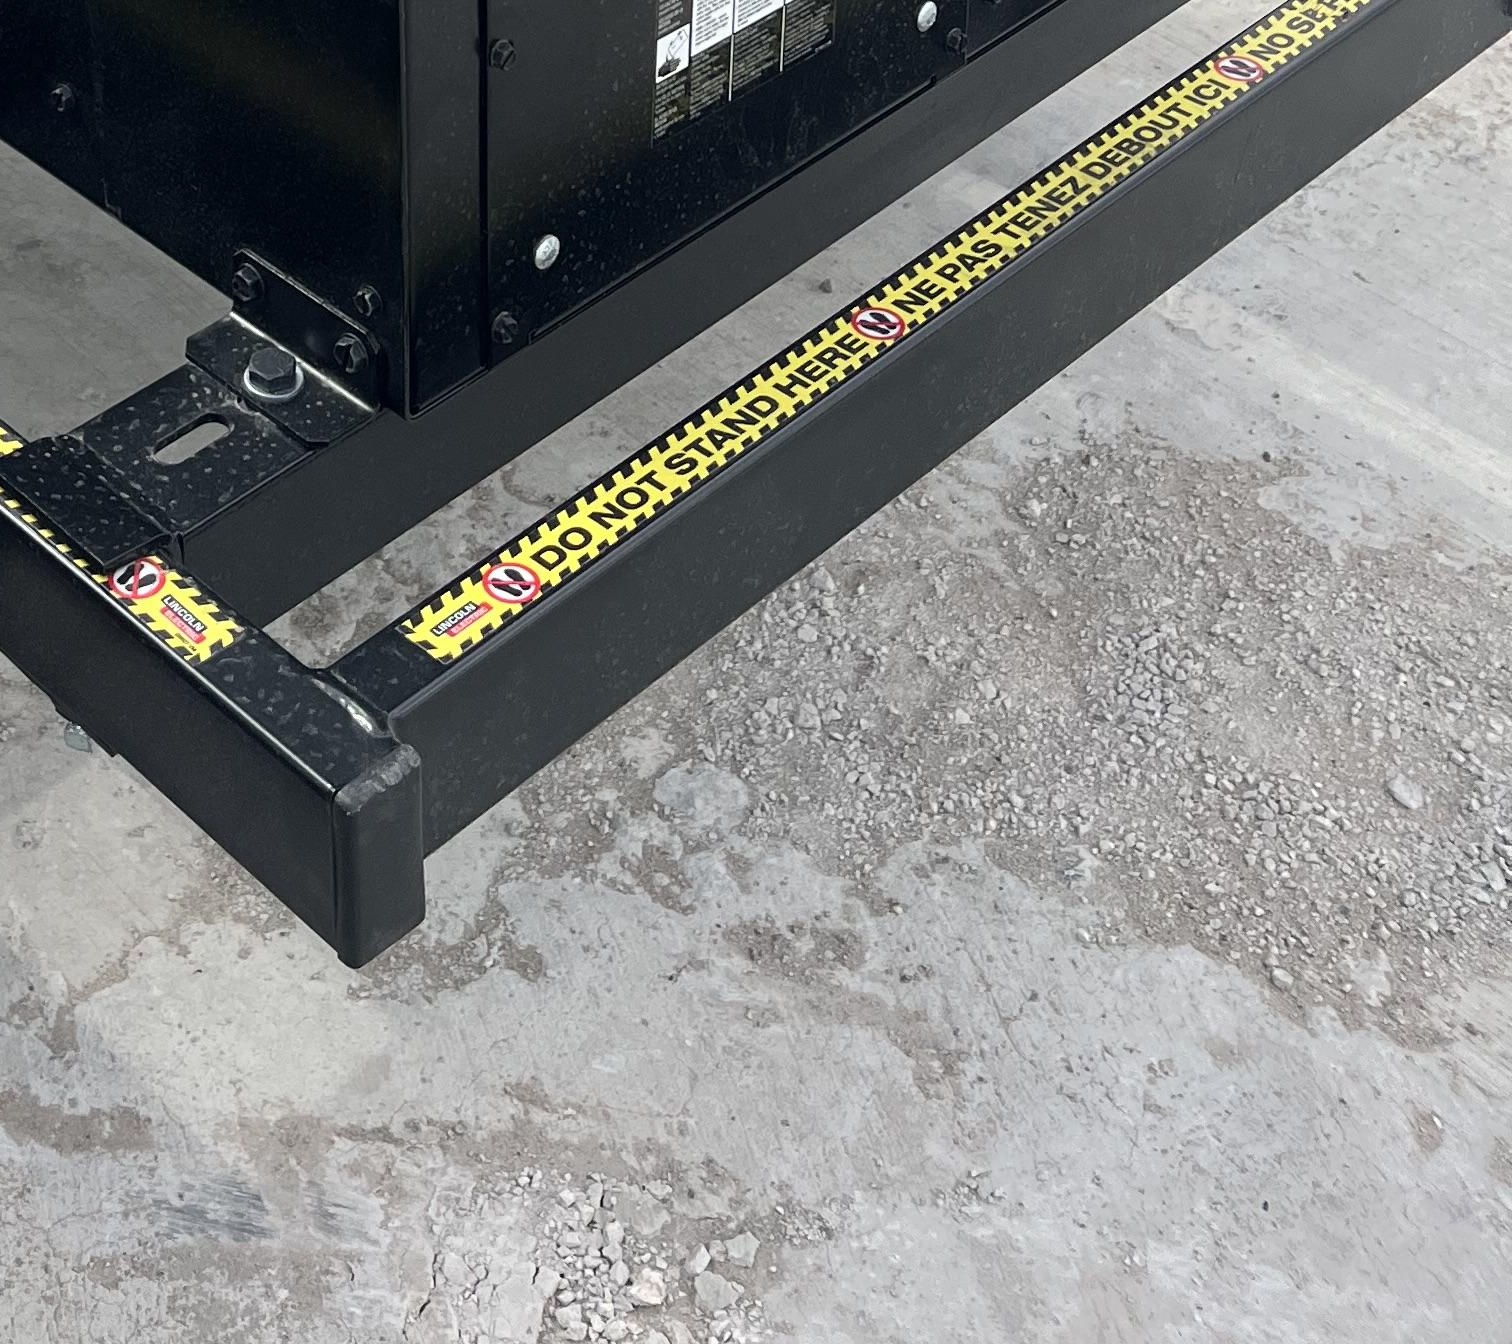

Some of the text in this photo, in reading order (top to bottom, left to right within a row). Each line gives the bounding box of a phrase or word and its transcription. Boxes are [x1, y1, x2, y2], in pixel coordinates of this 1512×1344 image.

[1248, 32, 1295, 63] NO
[1286, 5, 1324, 34] SE
[890, 78, 1231, 317] NE PAS TENEZ DEBOUT ICI
[530, 331, 870, 572] DO NOT STAND HERE
[163, 596, 205, 633] LINCOLN
